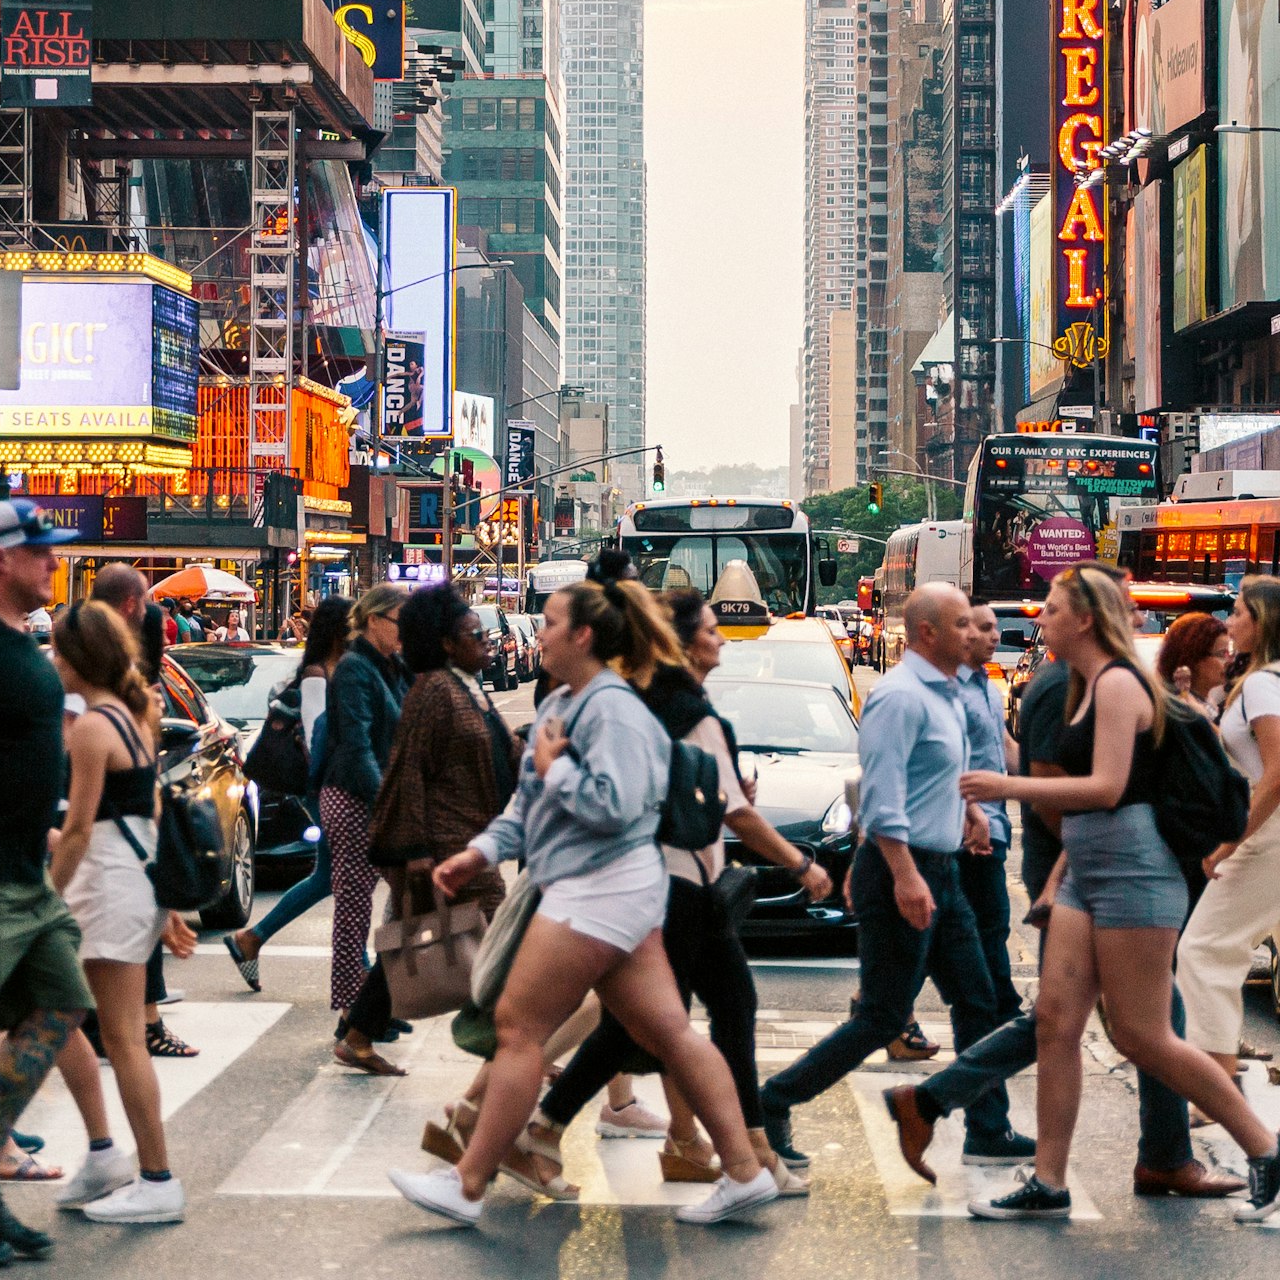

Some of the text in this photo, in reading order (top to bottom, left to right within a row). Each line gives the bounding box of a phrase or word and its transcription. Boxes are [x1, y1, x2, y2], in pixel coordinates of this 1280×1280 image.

[10, 10, 84, 39] ALL
[4, 38, 91, 66] RISE
[1167, 40, 1199, 83] Hideaway
[386, 348, 406, 424] DANCE
[12, 411, 71, 427] SEATS
[80, 411, 150, 427] AVAILA
[990, 446, 1150, 459] OUR FAMILY OF NYC EXPERIENCES
[1075, 477, 1156, 488] THE DOWNTOWN
[1087, 485, 1143, 494] EXPERIENCE
[1039, 529, 1086, 539] WANTED:
[1033, 543, 1048, 551] The
[1049, 543, 1073, 551] World's
[721, 603, 750, 614] 9K79
